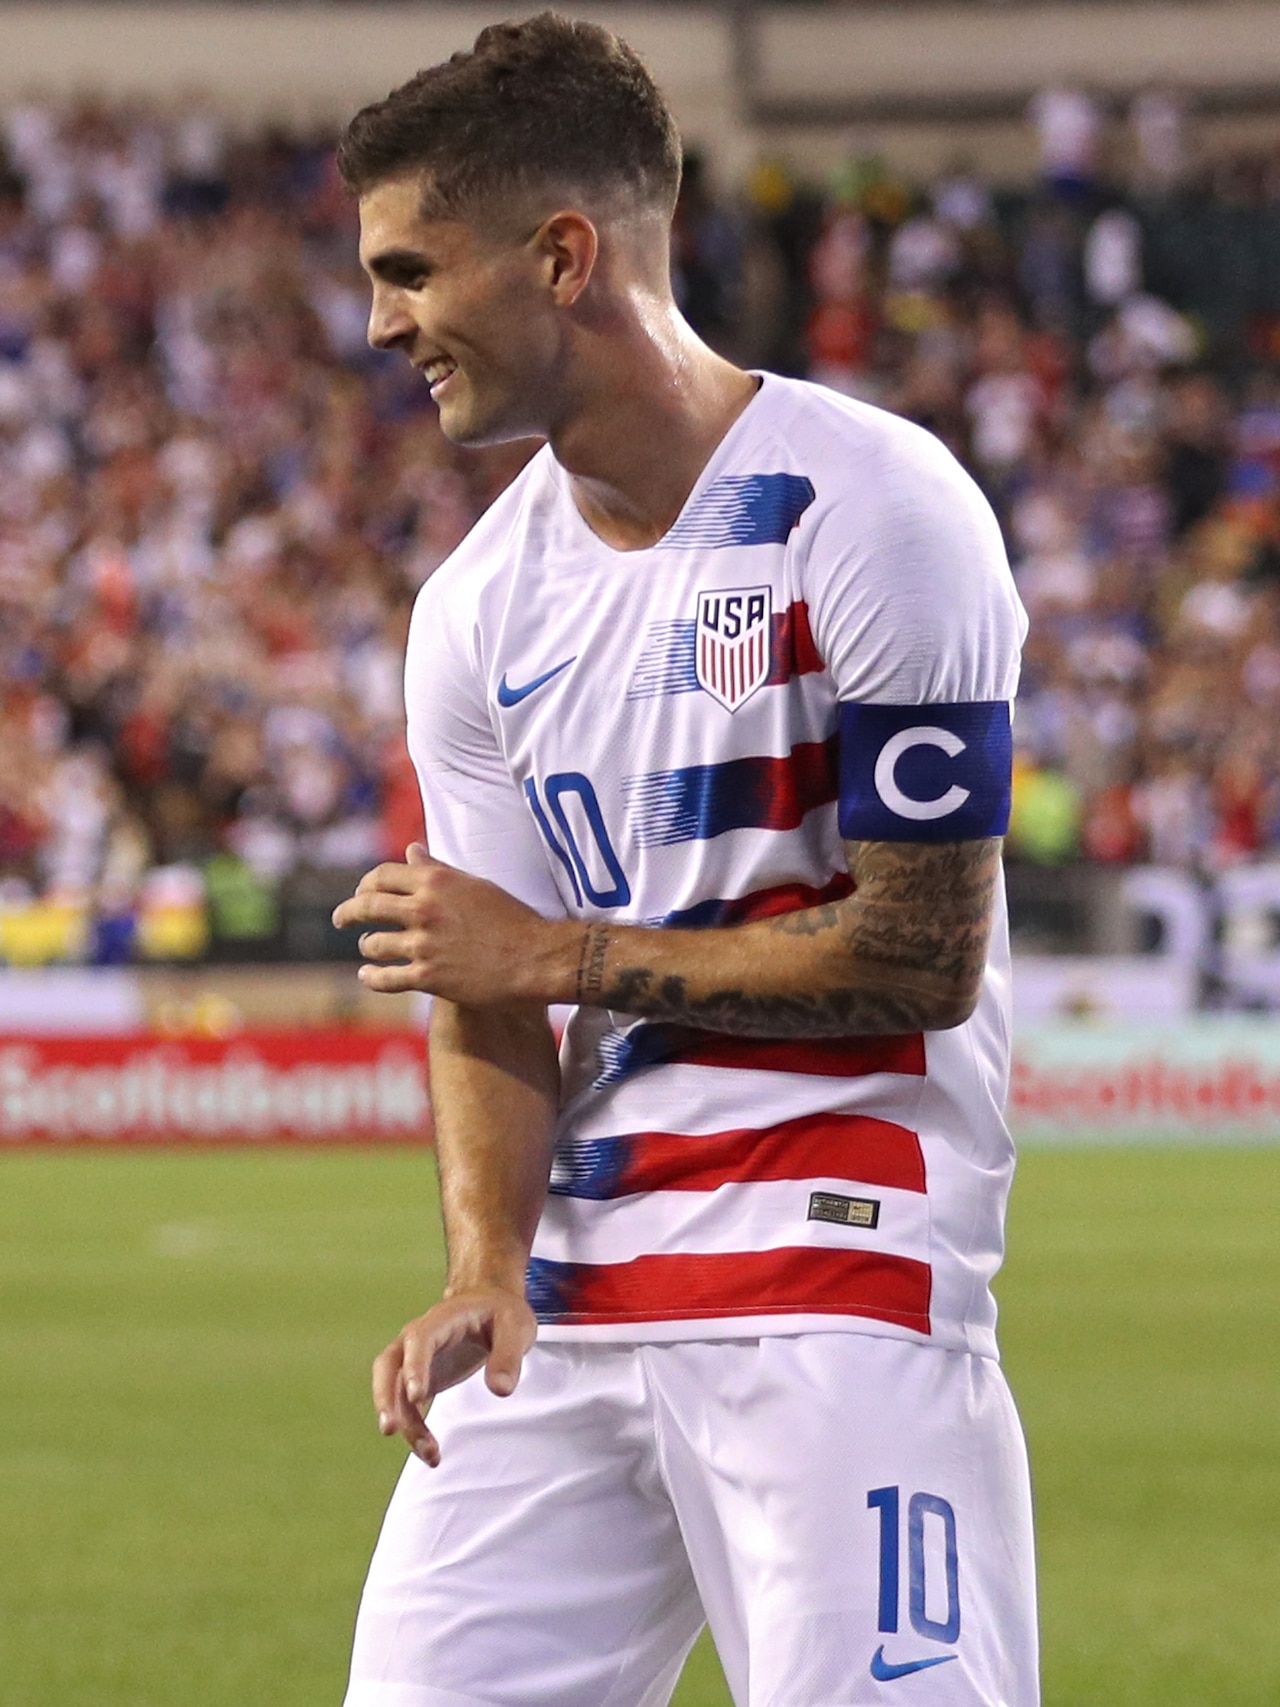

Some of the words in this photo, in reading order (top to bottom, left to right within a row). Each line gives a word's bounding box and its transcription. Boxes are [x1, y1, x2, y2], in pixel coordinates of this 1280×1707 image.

[703, 595, 764, 640] USA
[874, 726, 971, 821] C
[524, 771, 631, 908] 10
[867, 1484, 961, 1645] 10
